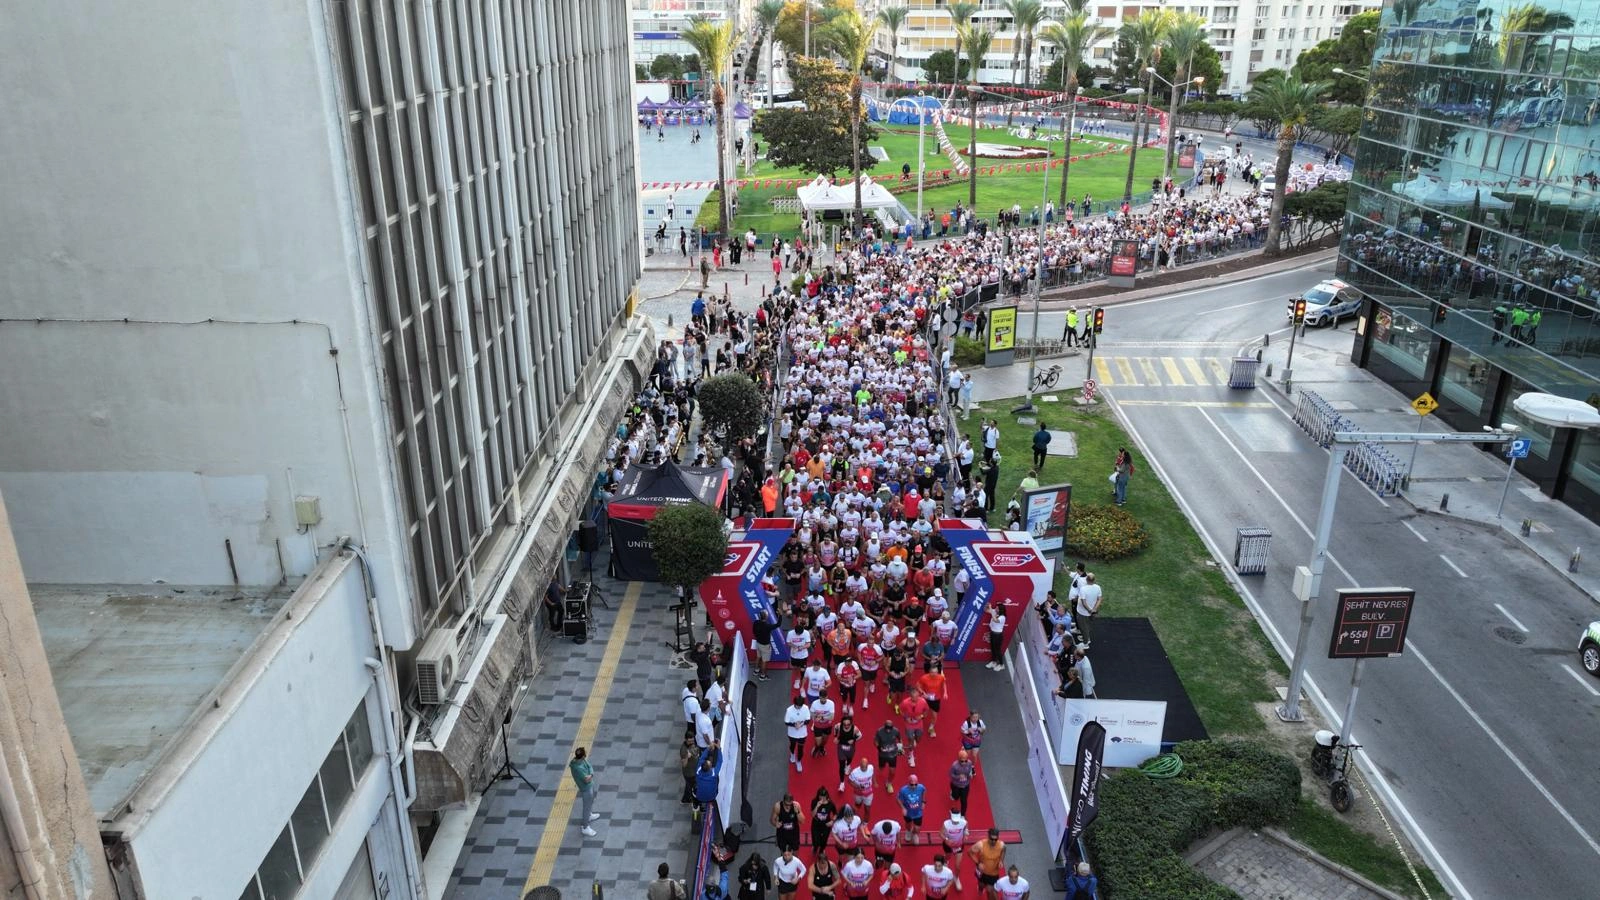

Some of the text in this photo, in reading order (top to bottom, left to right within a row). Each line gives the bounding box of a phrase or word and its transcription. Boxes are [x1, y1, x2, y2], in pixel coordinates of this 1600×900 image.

[627, 540, 654, 549] UNITE
[746, 545, 772, 583] START
[956, 545, 987, 580] FINISH
[745, 589, 763, 610] 21K
[972, 586, 989, 610] 21K
[1372, 600, 1407, 609] NEVRES
[1349, 630, 1368, 639] 550
[1380, 625, 1391, 637] P
[1080, 748, 1093, 797] TIMING
